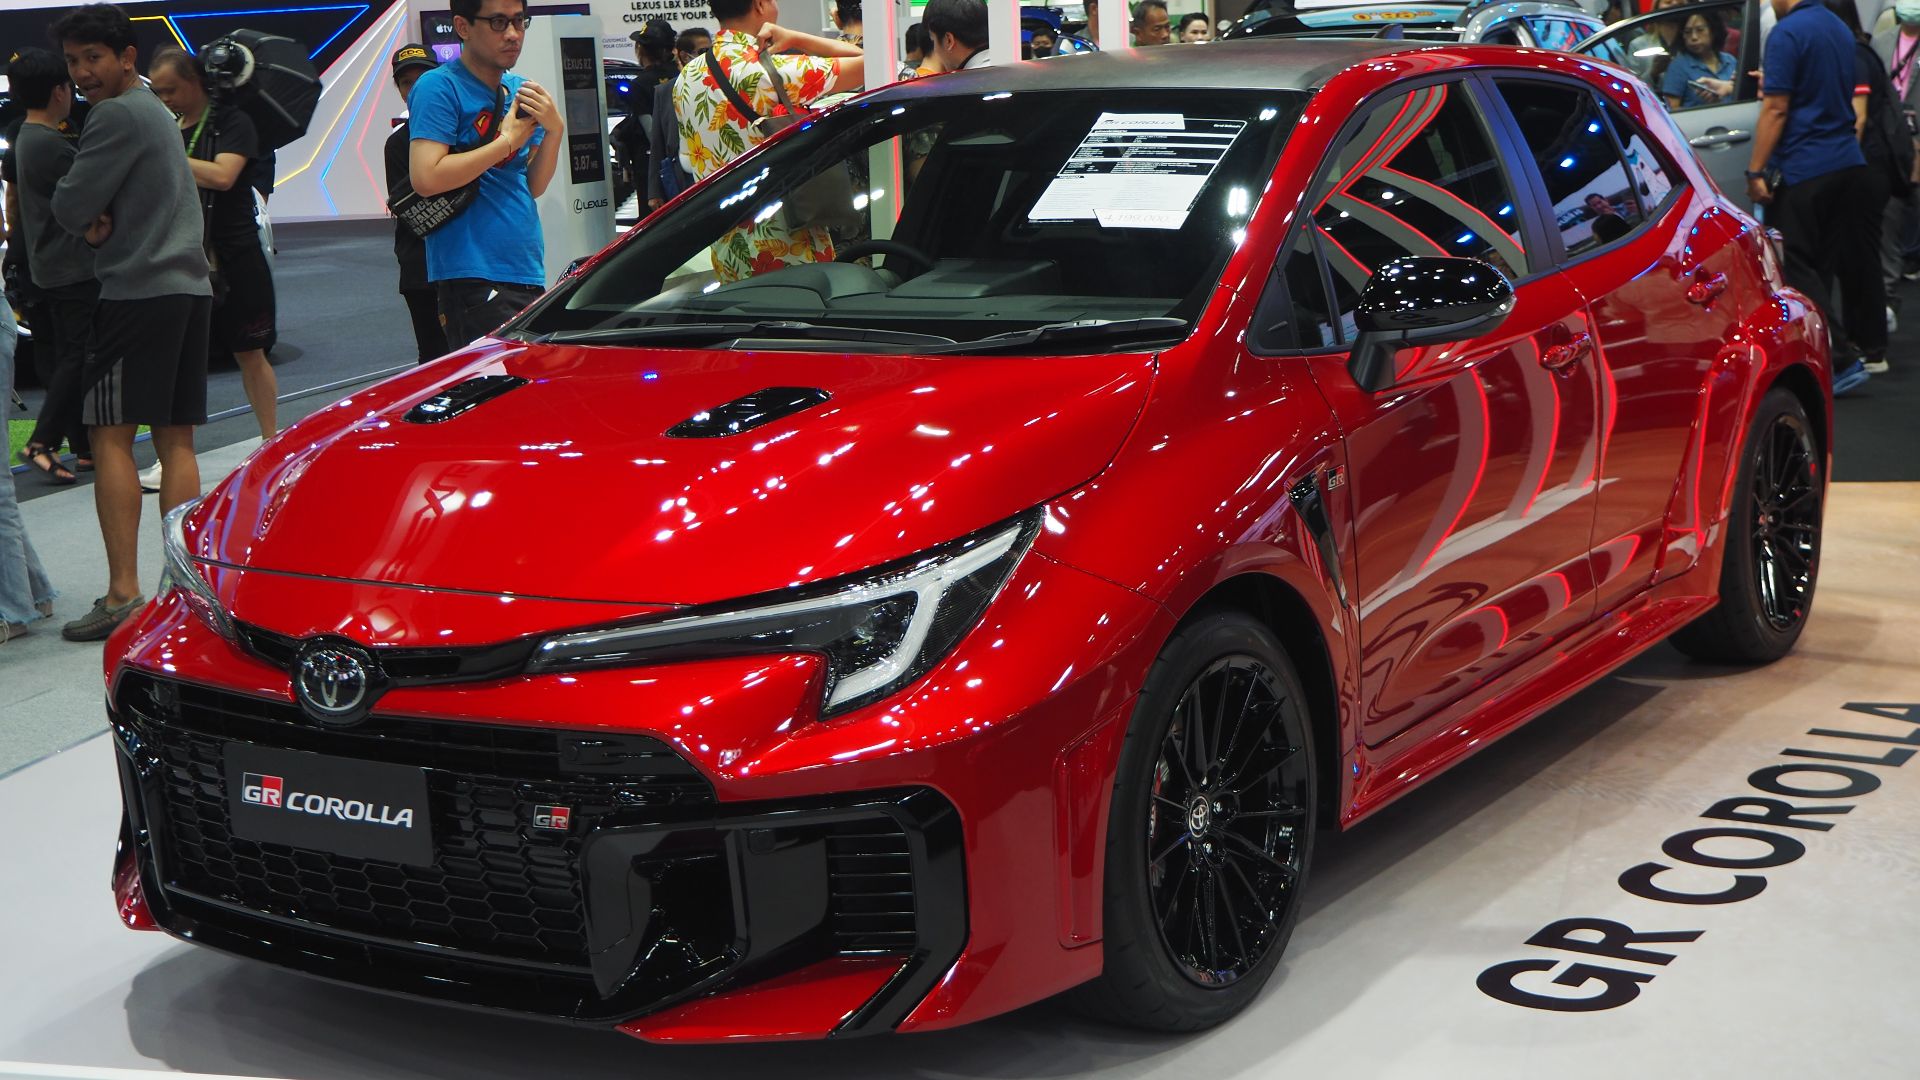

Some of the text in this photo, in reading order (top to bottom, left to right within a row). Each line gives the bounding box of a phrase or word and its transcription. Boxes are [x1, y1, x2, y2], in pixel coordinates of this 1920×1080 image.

[631, 0, 661, 10] LEXUS
[663, 0, 681, 9] LBX
[622, 12, 678, 23] CUSTOMIZE
[680, 11, 707, 20] YOUR
[564, 57, 583, 71] LEXUS
[582, 199, 608, 210] LEXUS
[286, 792, 414, 829] COROLLA
[1475, 701, 1920, 1013] GR COROLLA
